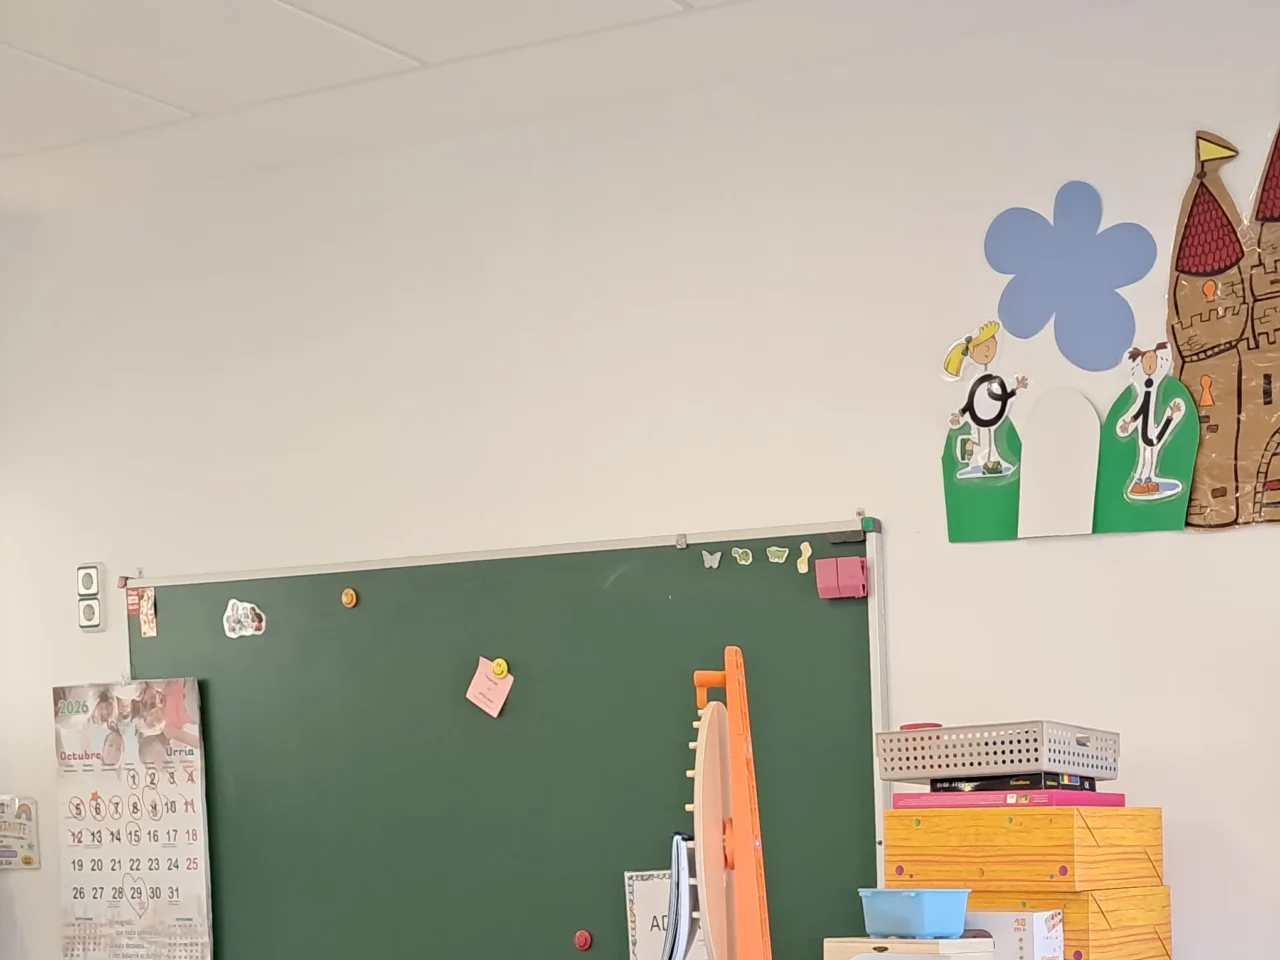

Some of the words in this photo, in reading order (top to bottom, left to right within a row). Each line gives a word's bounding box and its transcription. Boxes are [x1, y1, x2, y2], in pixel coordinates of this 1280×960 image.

[962, 374, 1015, 428] o
[59, 700, 89, 715] 2026
[165, 746, 194, 757] Urria
[164, 801, 177, 814] 10
[91, 830, 103, 844] 13
[110, 829, 122, 844] 14
[128, 830, 140, 843] 15
[147, 829, 159, 843] 16
[166, 829, 178, 842] 17
[185, 829, 198, 842] 18
[71, 859, 84, 872] 19
[90, 859, 103, 872] 20
[110, 858, 122, 871] 21
[129, 858, 141, 871] 22
[147, 858, 160, 871] 23
[167, 858, 180, 871] 24
[186, 857, 199, 871] 25
[72, 887, 85, 900] 26
[92, 887, 105, 900] 27
[111, 887, 124, 900] 28
[130, 887, 142, 900] 29
[149, 886, 161, 899] 30
[168, 886, 180, 899] 31
